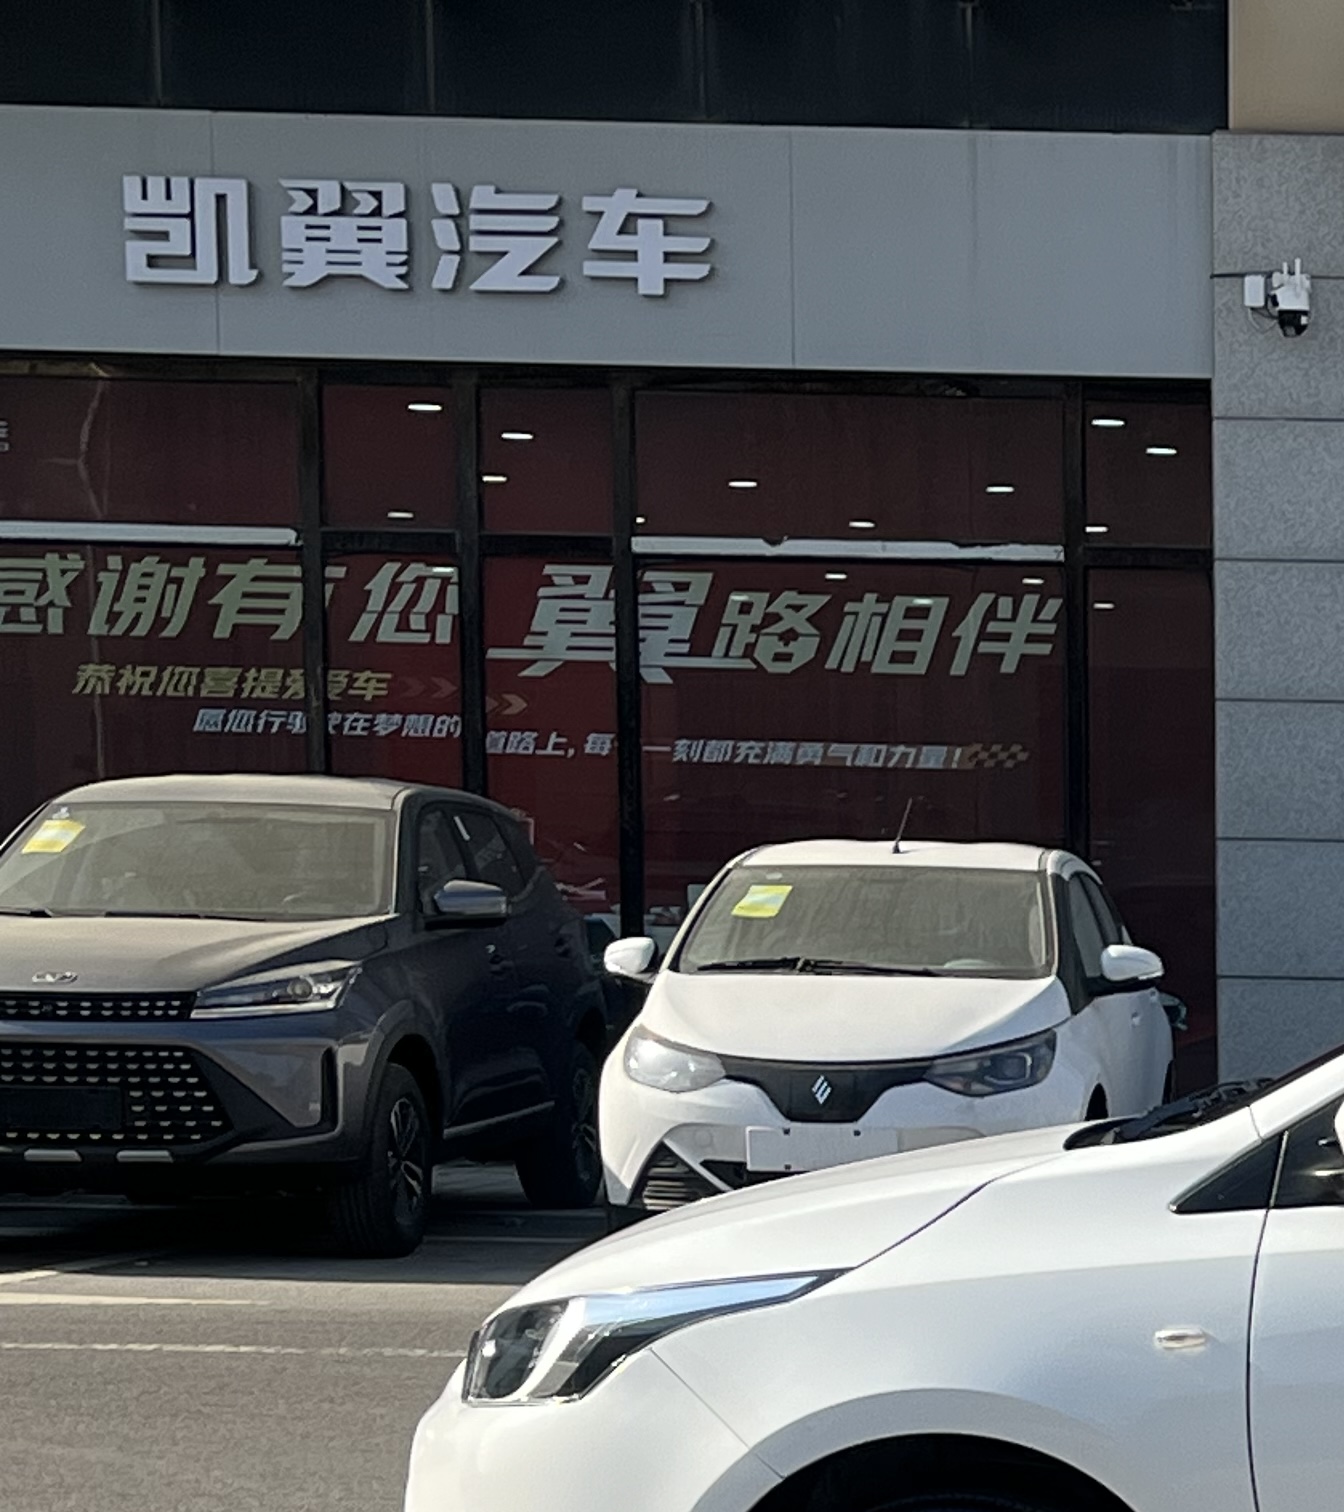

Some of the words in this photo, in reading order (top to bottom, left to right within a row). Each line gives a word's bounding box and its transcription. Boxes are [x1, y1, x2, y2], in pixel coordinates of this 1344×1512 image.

[122, 174, 711, 297] 凯翼汽车
[0, 551, 460, 645] 感谢有您
[486, 563, 1064, 685] 翼路相伴
